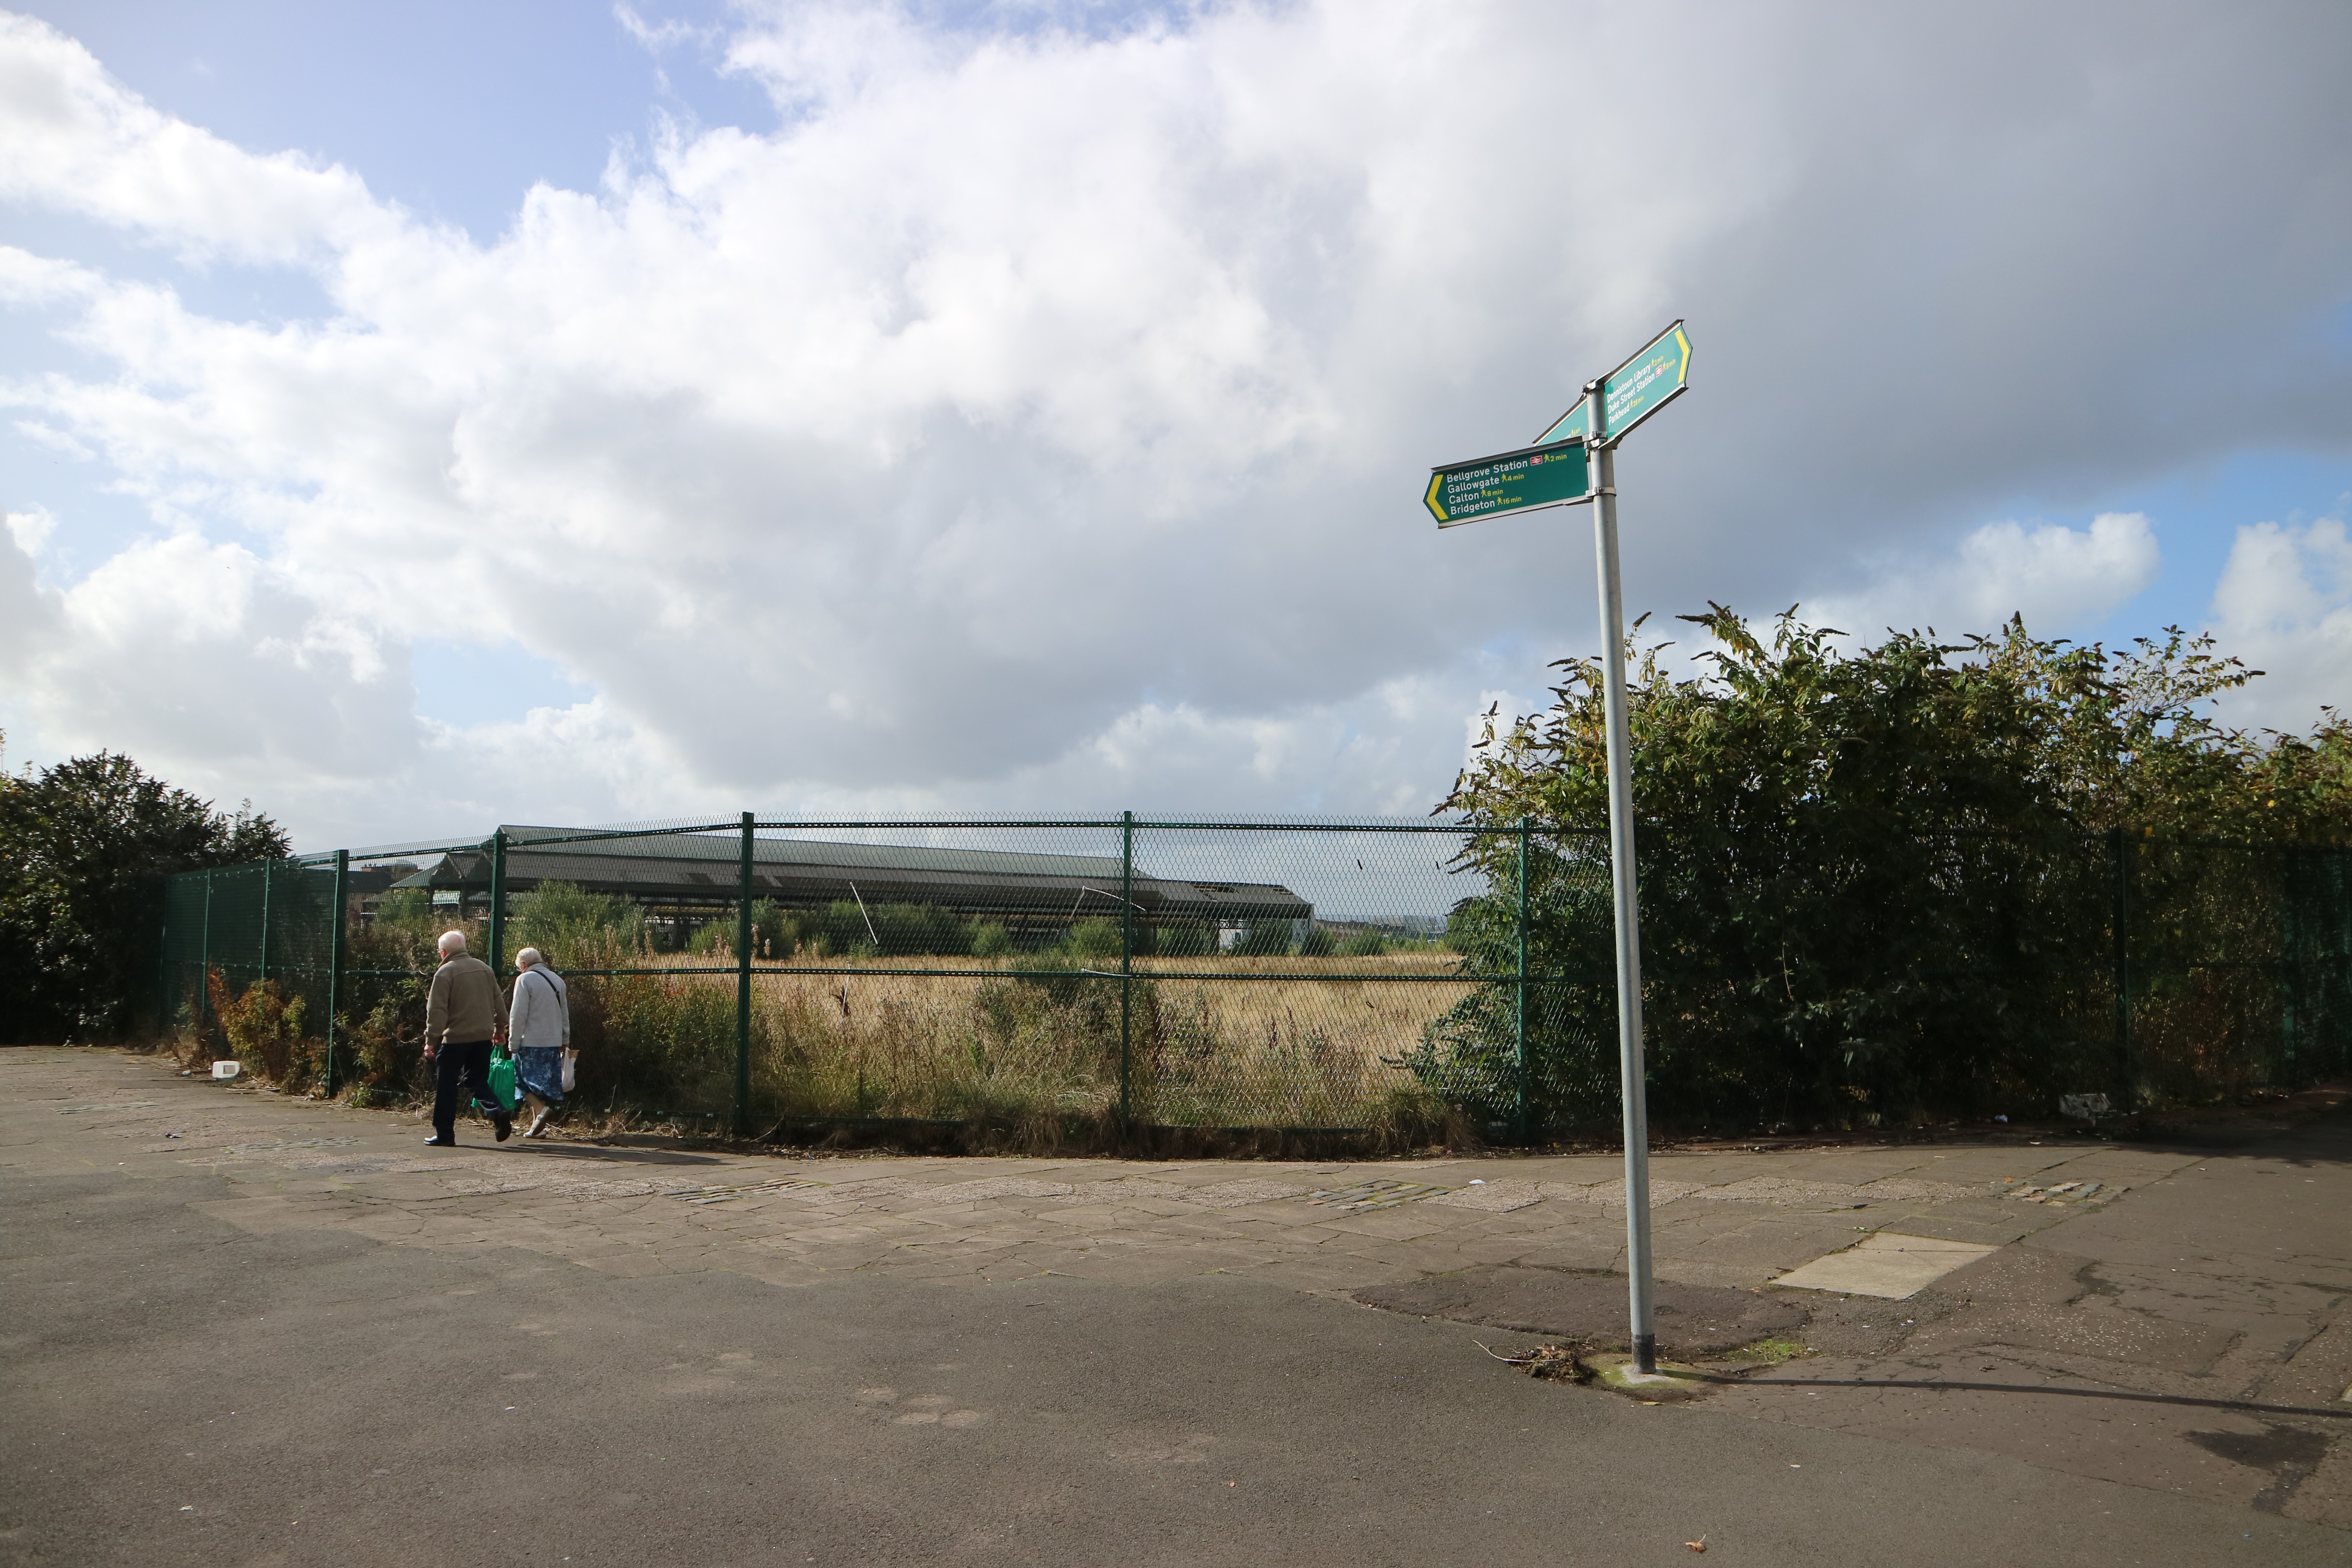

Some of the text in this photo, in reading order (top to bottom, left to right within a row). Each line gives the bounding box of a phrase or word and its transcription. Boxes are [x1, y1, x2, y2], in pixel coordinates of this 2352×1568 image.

[1607, 378, 1633, 403] Dennistoun
[1634, 363, 1651, 383] Library
[1608, 401, 1620, 415] Duke
[1621, 386, 1635, 405] Street
[1637, 373, 1655, 392] Station
[1608, 402, 1630, 426] Parkhead
[1447, 468, 1490, 483] Bellgrove
[1493, 460, 1528, 474] Station
[1448, 476, 1499, 494] Gallowgate
[1449, 492, 1479, 504] Calton
[1450, 500, 1495, 515] Bridgeton
